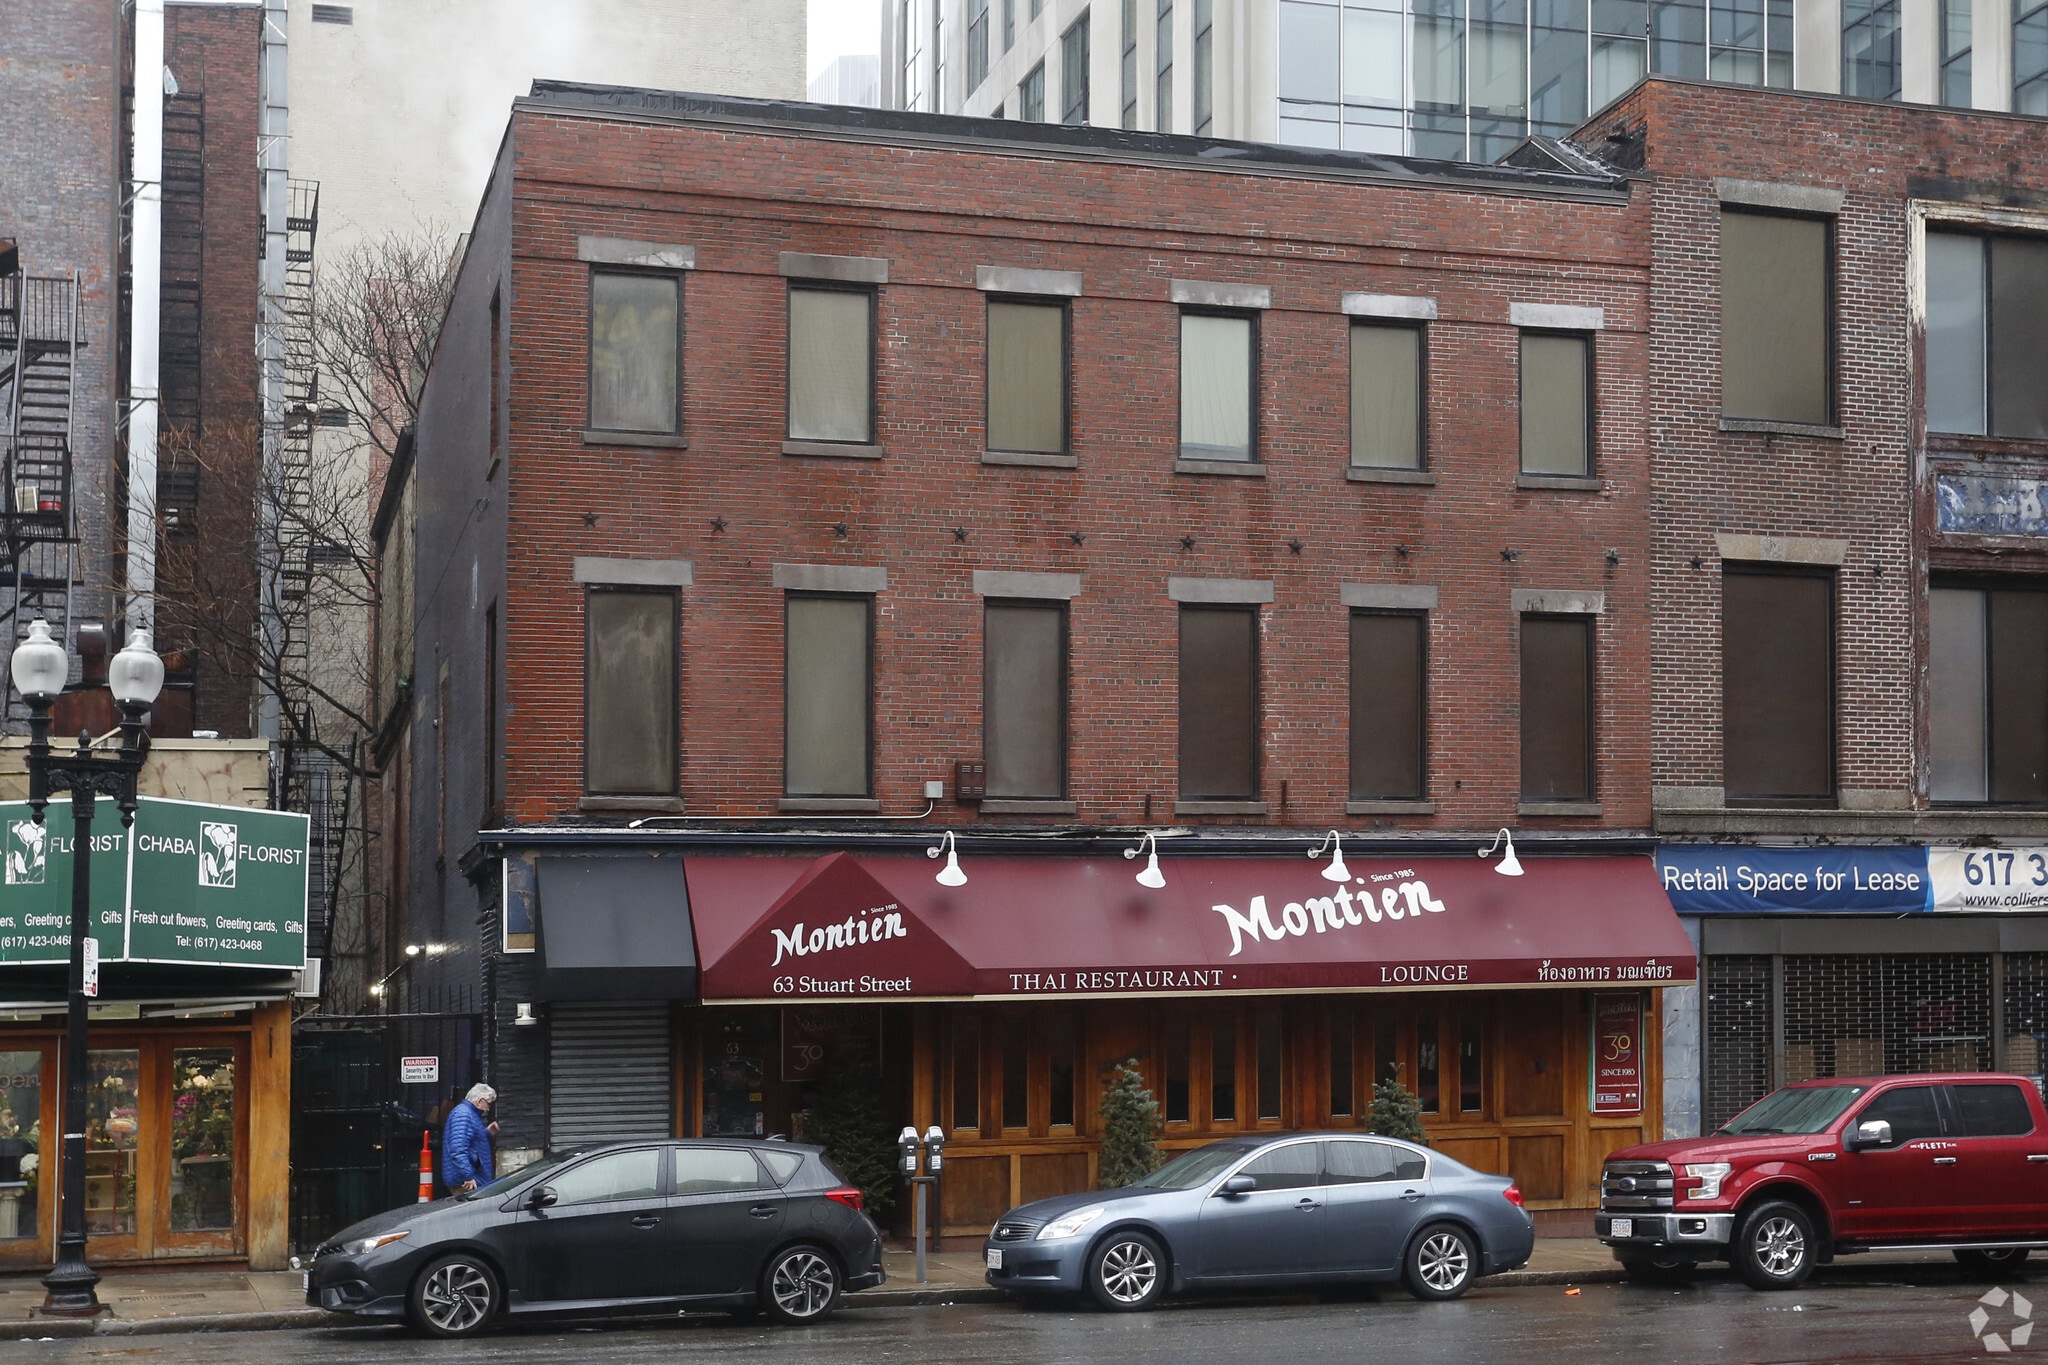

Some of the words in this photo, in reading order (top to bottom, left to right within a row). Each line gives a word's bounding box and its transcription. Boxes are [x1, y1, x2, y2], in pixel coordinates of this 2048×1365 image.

[139, 835, 195, 855] CHABA
[239, 844, 303, 865] FLORIST
[1370, 872, 1393, 883] Since
[1394, 868, 1415, 879] 1985
[1964, 852, 2015, 886] 617
[2028, 853, 2048, 887] 3
[1663, 865, 1729, 891] Retail
[1736, 866, 1808, 898] Space
[1815, 866, 1847, 891] for
[1853, 866, 1921, 891] Lease
[870, 905, 885, 914] Since
[885, 903, 898, 911] 1985
[1212, 877, 1446, 957] Montien
[25, 913, 63, 929] Greeting
[101, 911, 122, 924] Gifts
[133, 910, 158, 925] Fresh
[160, 915, 174, 926] cut
[176, 912, 209, 929] flowers,
[216, 915, 251, 933] Greeting
[253, 919, 278, 934] cards,
[285, 920, 303, 934] Gifts
[1, 936, 26, 949] (617)
[176, 935, 192, 947] Tel:
[194, 937, 218, 950] (617)
[220, 938, 262, 951] 423-0468
[771, 910, 907, 967] Montien
[1010, 973, 1067, 990] THAI
[1075, 970, 1224, 989] RESTAURANT
[1381, 965, 1469, 982] LOUNGE
[1538, 960, 1611, 981] ห้องอาหาร
[773, 976, 794, 993] 63
[799, 976, 855, 993] Stuart
[860, 975, 912, 993] Street
[1603, 1035, 1631, 1061] 30
[1919, 1142, 1947, 1150] FLETT
